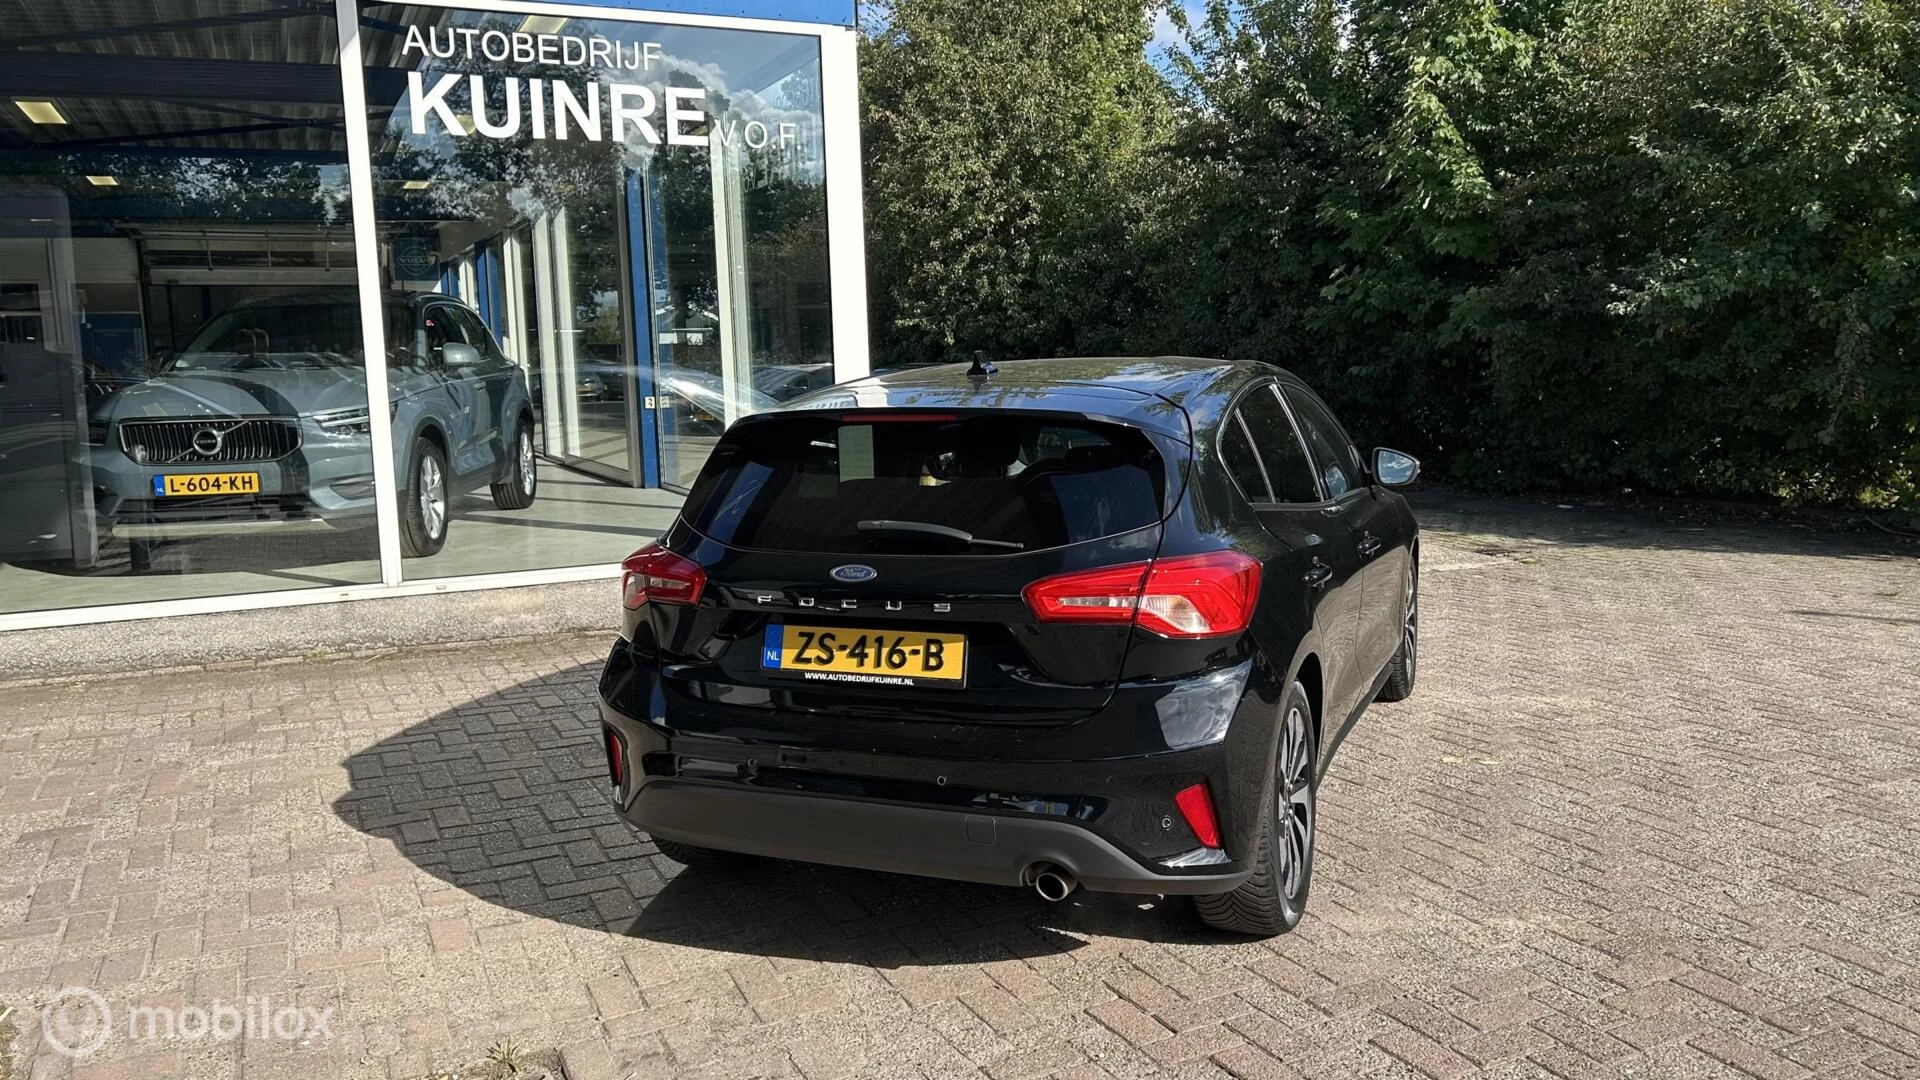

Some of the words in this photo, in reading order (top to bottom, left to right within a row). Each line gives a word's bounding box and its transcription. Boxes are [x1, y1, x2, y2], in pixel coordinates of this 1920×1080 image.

[402, 25, 661, 70] AUTOBEDRIJF
[408, 72, 709, 145] KUINRE
[714, 119, 801, 149] V.O.F.
[170, 475, 253, 493] L-604-KH
[757, 595, 950, 612] FOCUS
[767, 651, 780, 661] NL
[792, 632, 944, 671] ZS-416-B
[804, 672, 914, 686] WWW.AUTOBEDRIJFKUINRE.NL
